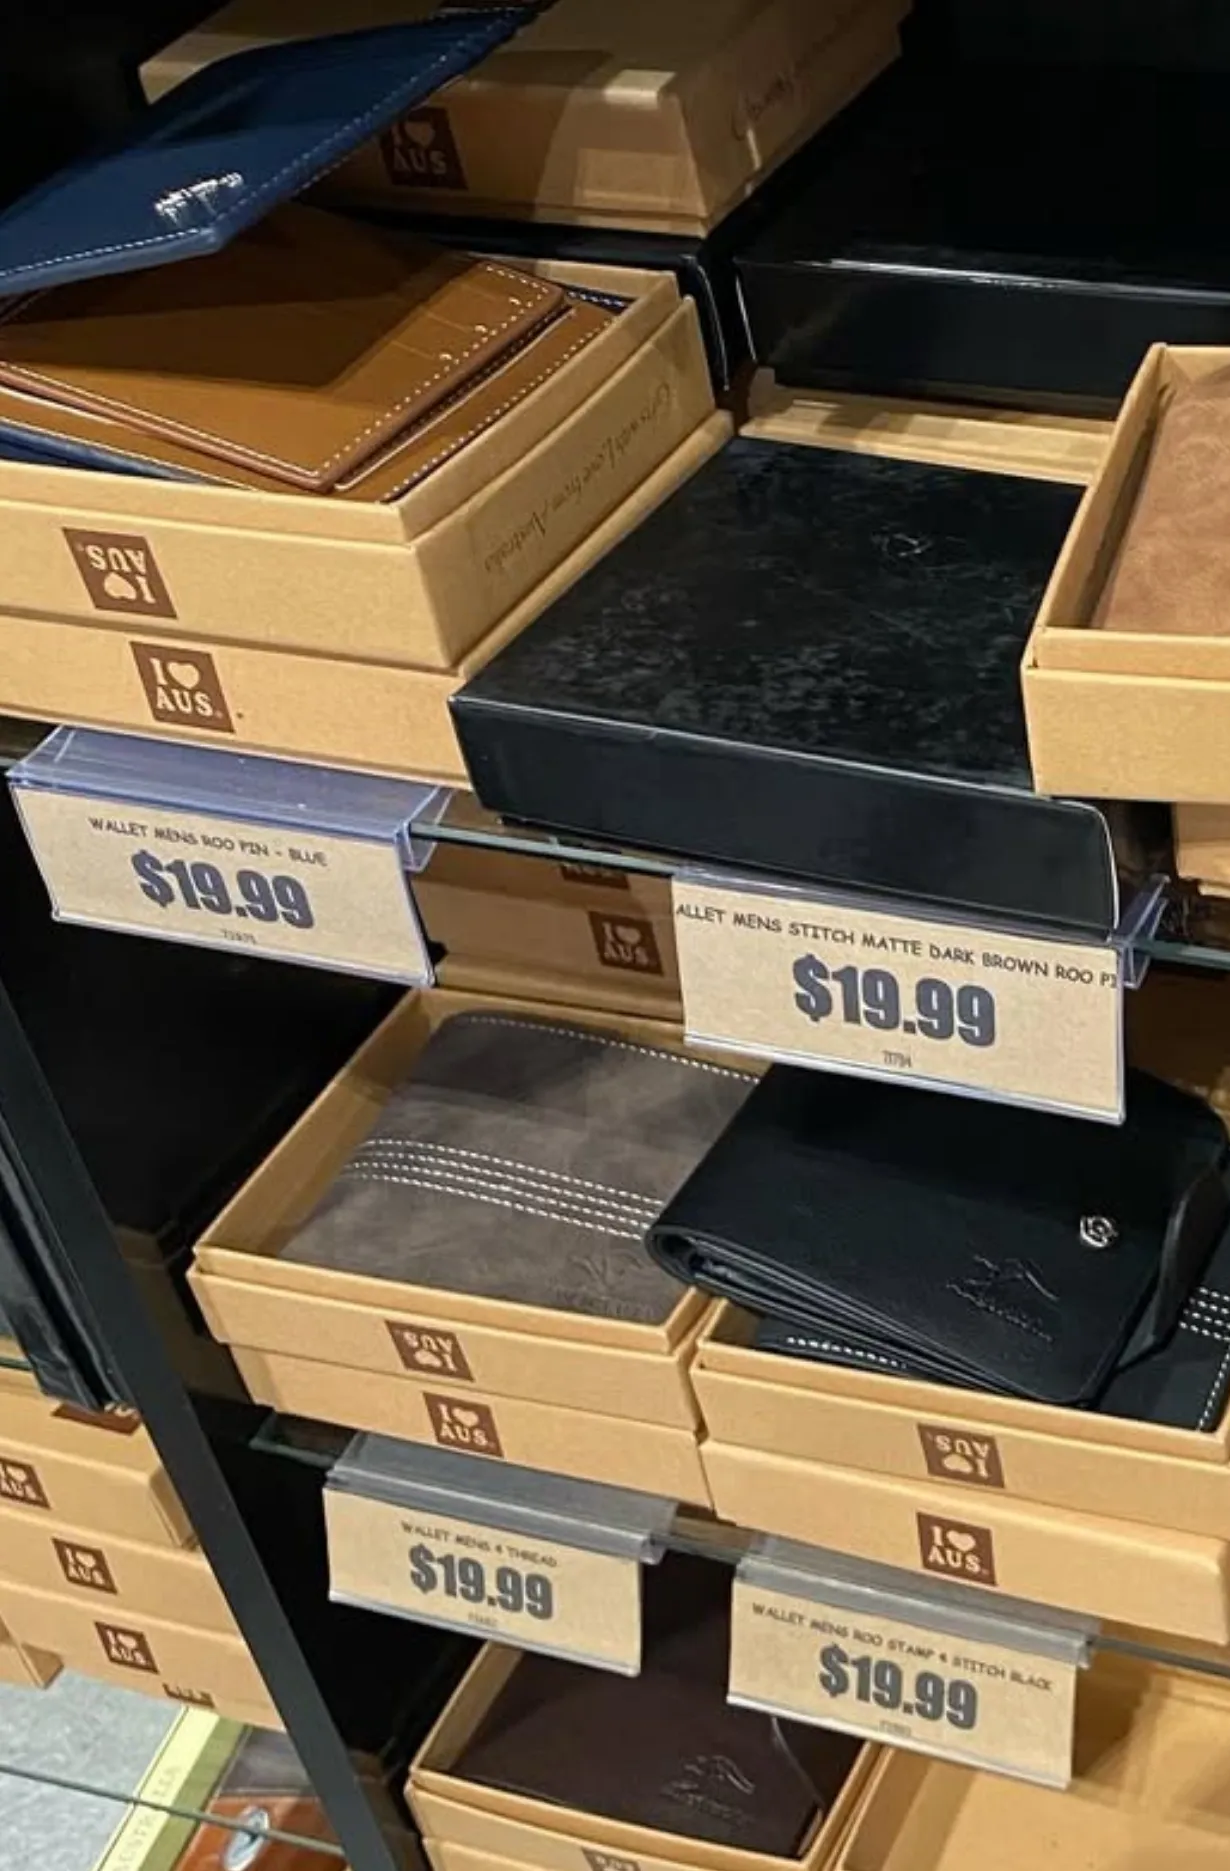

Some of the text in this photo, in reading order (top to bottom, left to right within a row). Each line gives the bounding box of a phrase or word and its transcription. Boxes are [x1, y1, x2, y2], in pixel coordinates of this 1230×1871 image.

[88, 817, 148, 838] WALLET
[154, 827, 198, 845] MENS
[201, 834, 235, 851] ROO
[238, 839, 269, 857] PIN
[288, 847, 328, 868] BLUE
[131, 848, 315, 929] $19.99
[733, 913, 782, 934] MENS
[788, 922, 854, 945] STITCH
[861, 932, 921, 956] MATTE
[929, 944, 974, 966] DARK
[982, 952, 1049, 977] BROWN
[1055, 965, 1094, 985] ROO
[792, 953, 996, 1047] $19.99
[401, 1520, 450, 1542] WALLET
[455, 1533, 491, 1552] MENS
[505, 1545, 558, 1568] THREAD
[408, 1542, 554, 1621] $19.99
[752, 1602, 804, 1625] WALLET
[810, 1618, 849, 1639] MENS
[852, 1628, 883, 1647] ROO
[887, 1639, 934, 1660] STAMP
[952, 1656, 1006, 1679] STITCH
[1010, 1669, 1052, 1691] BLACK
[819, 1643, 978, 1731] $19.99
